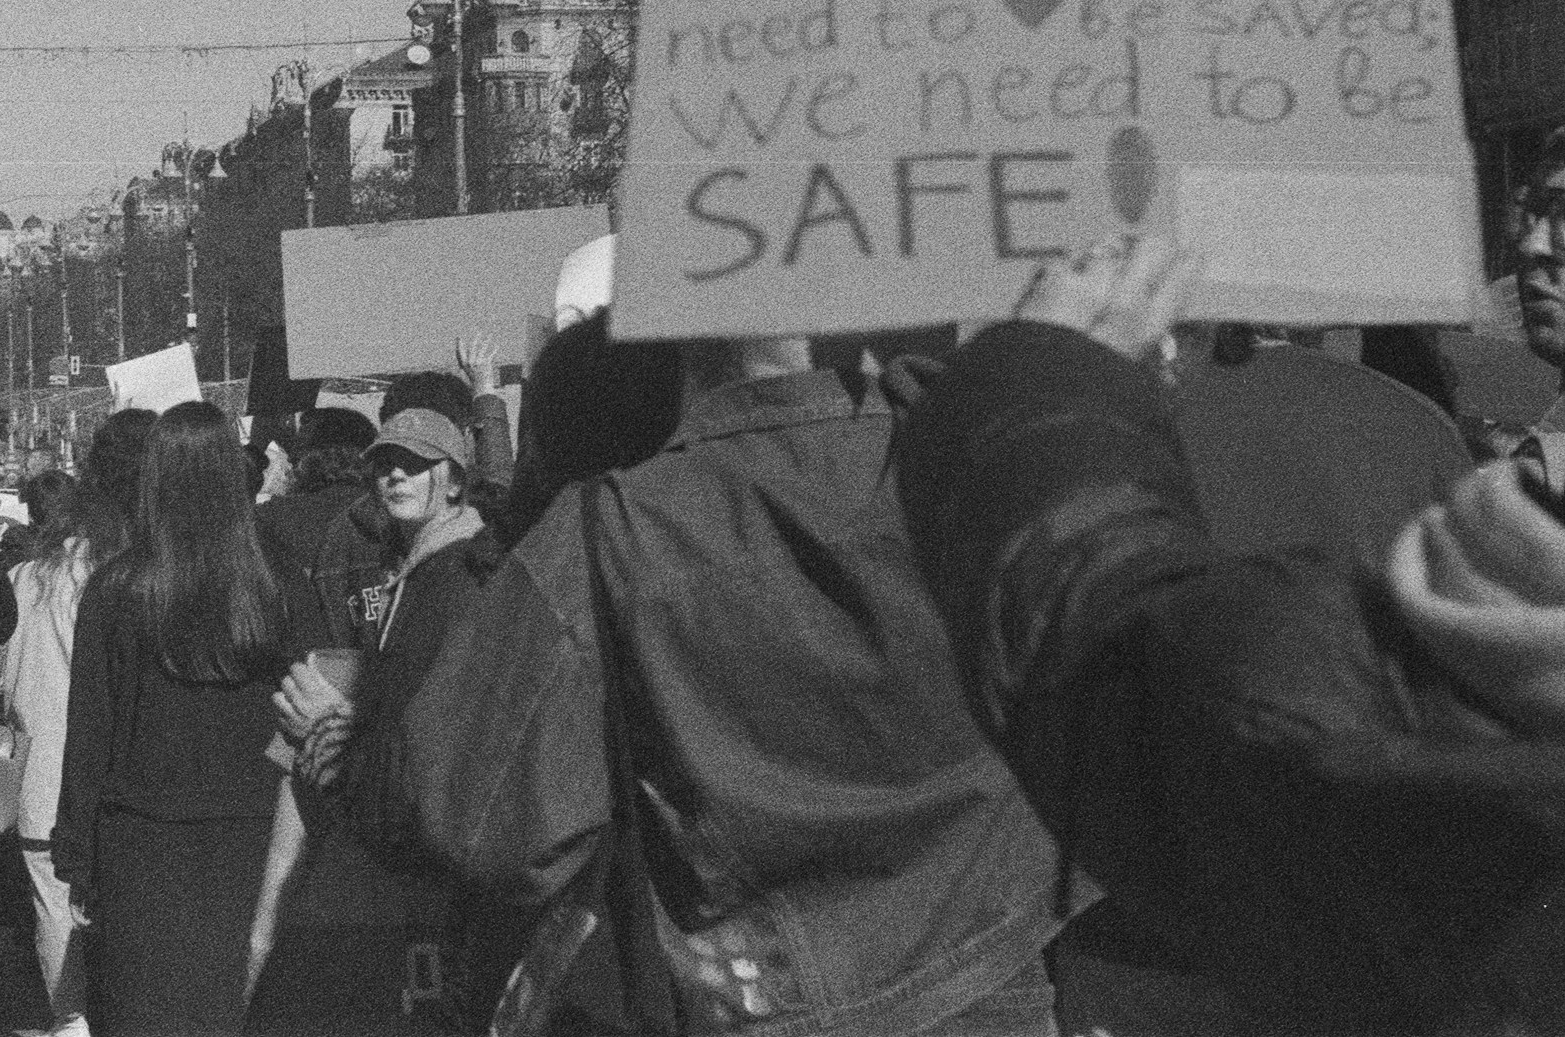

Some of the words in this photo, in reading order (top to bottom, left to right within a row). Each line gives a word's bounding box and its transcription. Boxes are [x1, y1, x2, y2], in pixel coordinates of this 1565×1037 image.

[918, 37, 1142, 133] need
[1192, 43, 1299, 126] to
[1336, 46, 1438, 126] be
